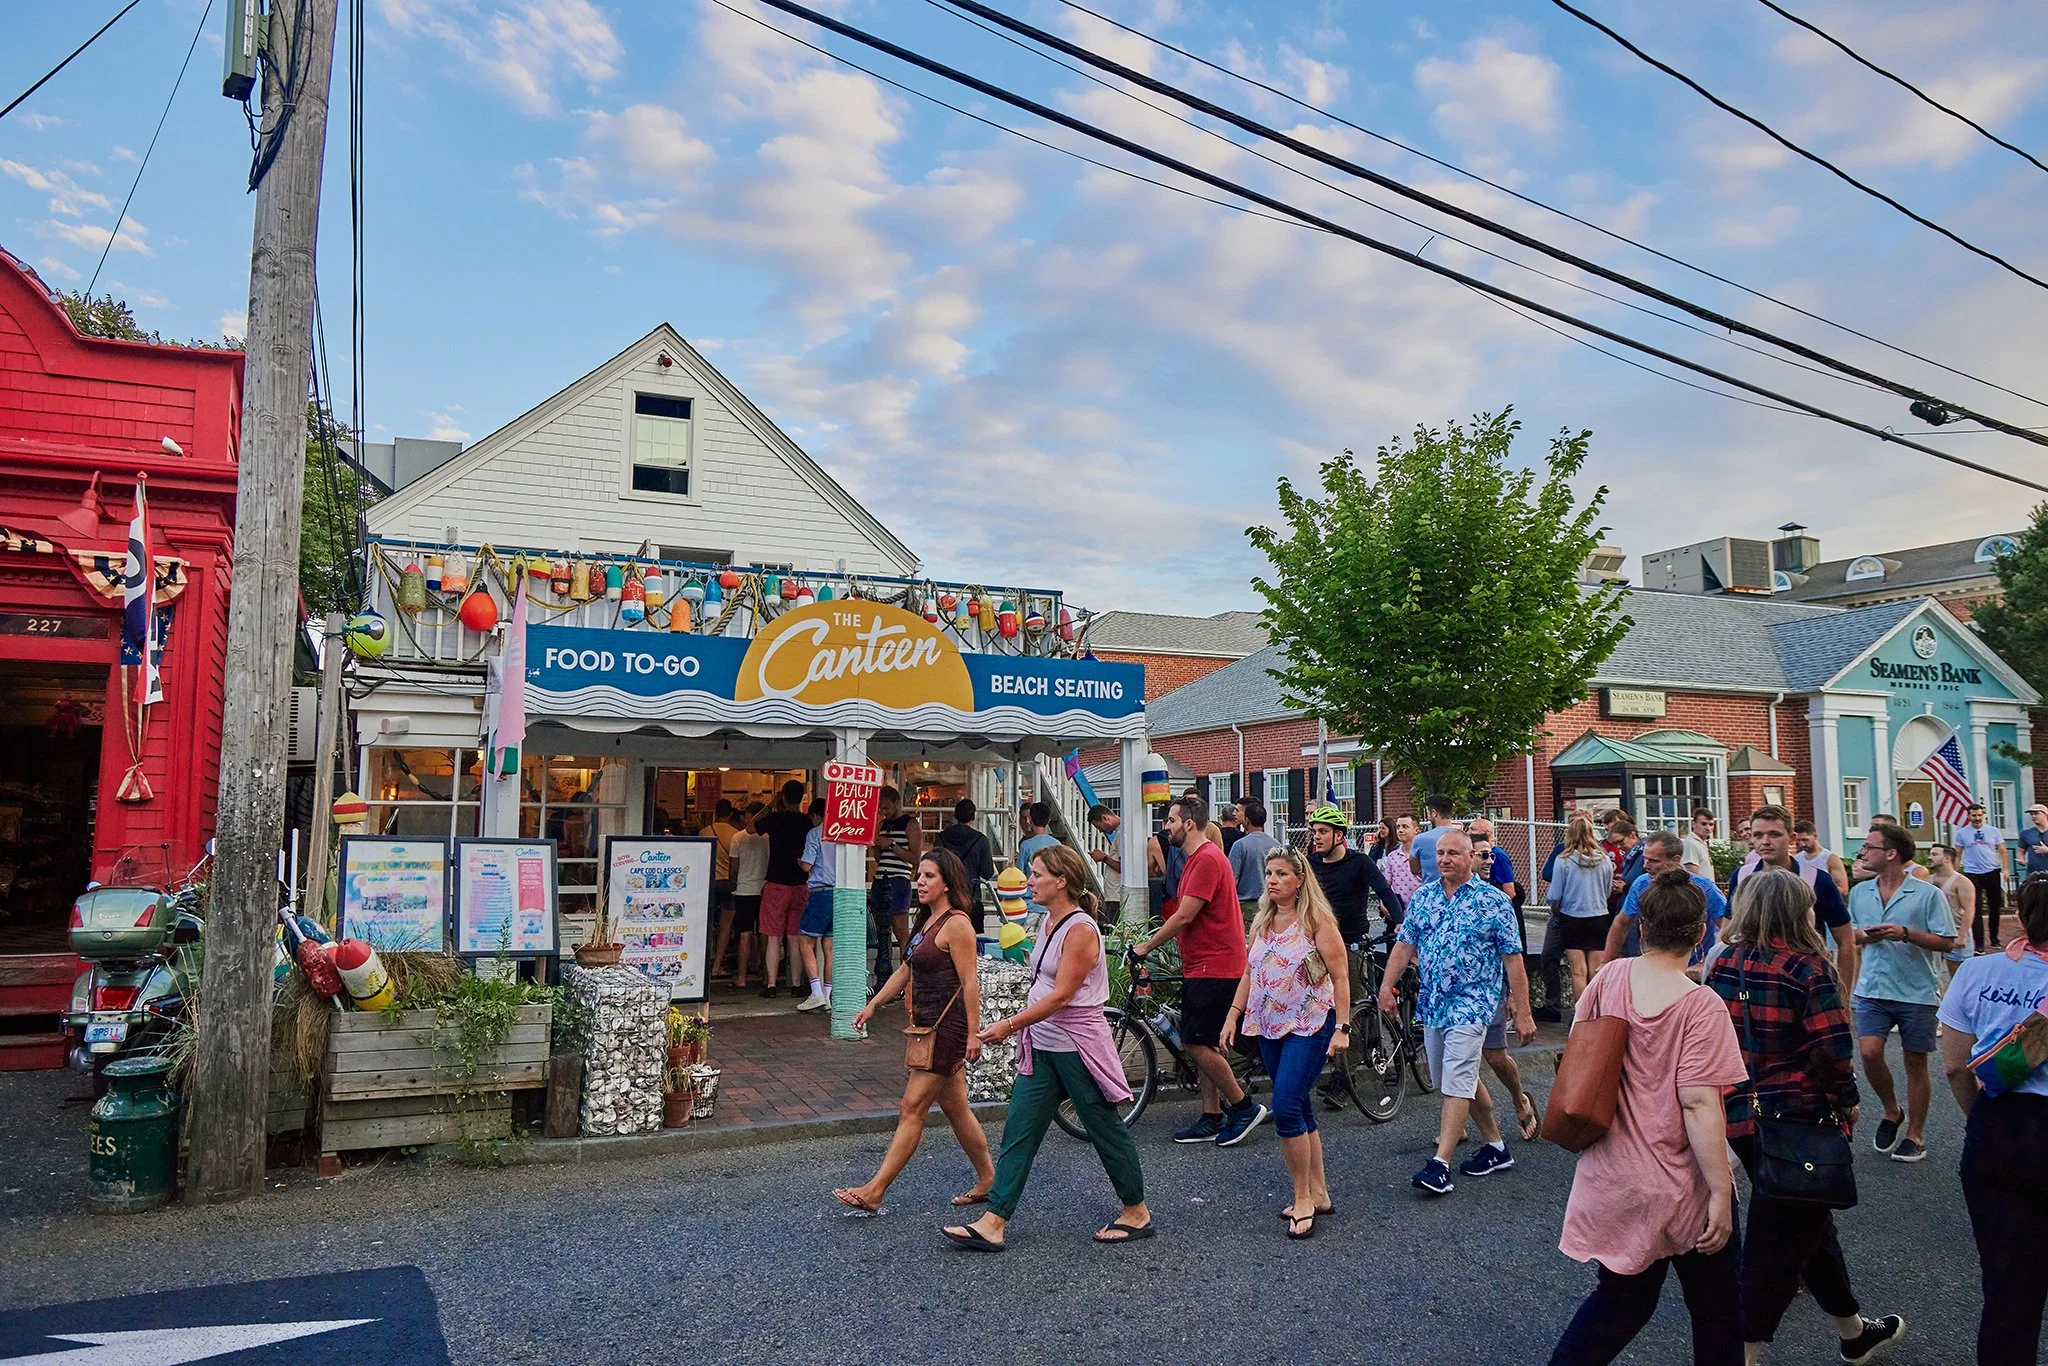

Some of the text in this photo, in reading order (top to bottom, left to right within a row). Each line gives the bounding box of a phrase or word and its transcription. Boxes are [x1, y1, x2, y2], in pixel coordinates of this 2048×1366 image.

[27, 618, 62, 632] 227
[833, 612, 861, 627] THE
[545, 648, 615, 672] FOOD
[622, 652, 700, 677] TO-GO
[759, 616, 942, 698] Canteen
[1870, 657, 1982, 684] SEAMEN'S BANK
[991, 674, 1123, 700] BEACH SEATING
[1890, 681, 1960, 692] MEMBER FDIC
[827, 764, 877, 783] OPEN
[835, 782, 873, 799] BEACH
[838, 799, 869, 820] BAR
[828, 821, 866, 841] Open
[640, 850, 671, 864] Canteen
[630, 867, 644, 875] CAPE
[657, 867, 682, 875] CLASSICS
[617, 926, 648, 935] COCKTAILS
[654, 926, 672, 934] CRAFT
[655, 955, 679, 963] SWEETS
[1979, 985, 2021, 1006] Keith
